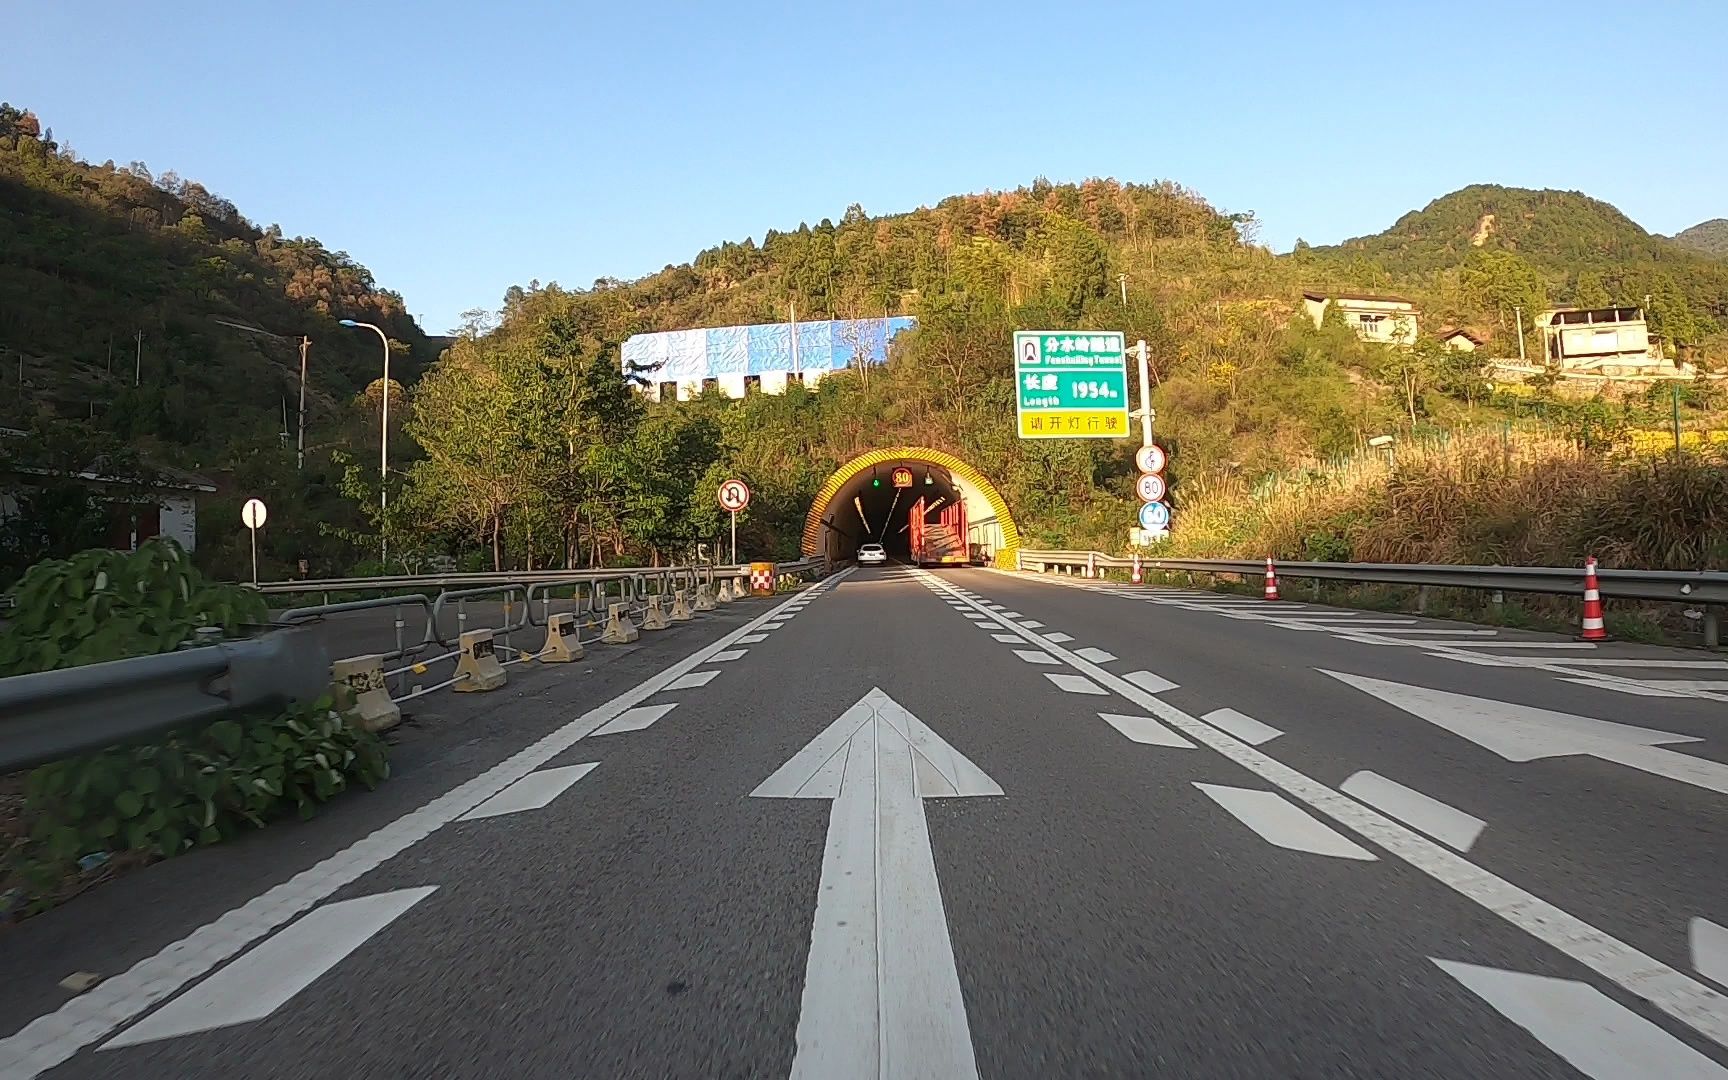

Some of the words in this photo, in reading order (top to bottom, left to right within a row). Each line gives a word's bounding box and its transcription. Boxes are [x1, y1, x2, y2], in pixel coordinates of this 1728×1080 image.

[1094, 355, 1122, 365] Tunnel
[1023, 373, 1058, 391] 长度
[1024, 396, 1059, 407] Length
[1031, 416, 1118, 430] 请开灯行驶
[895, 472, 909, 483] 80
[1145, 481, 1159, 495] 80
